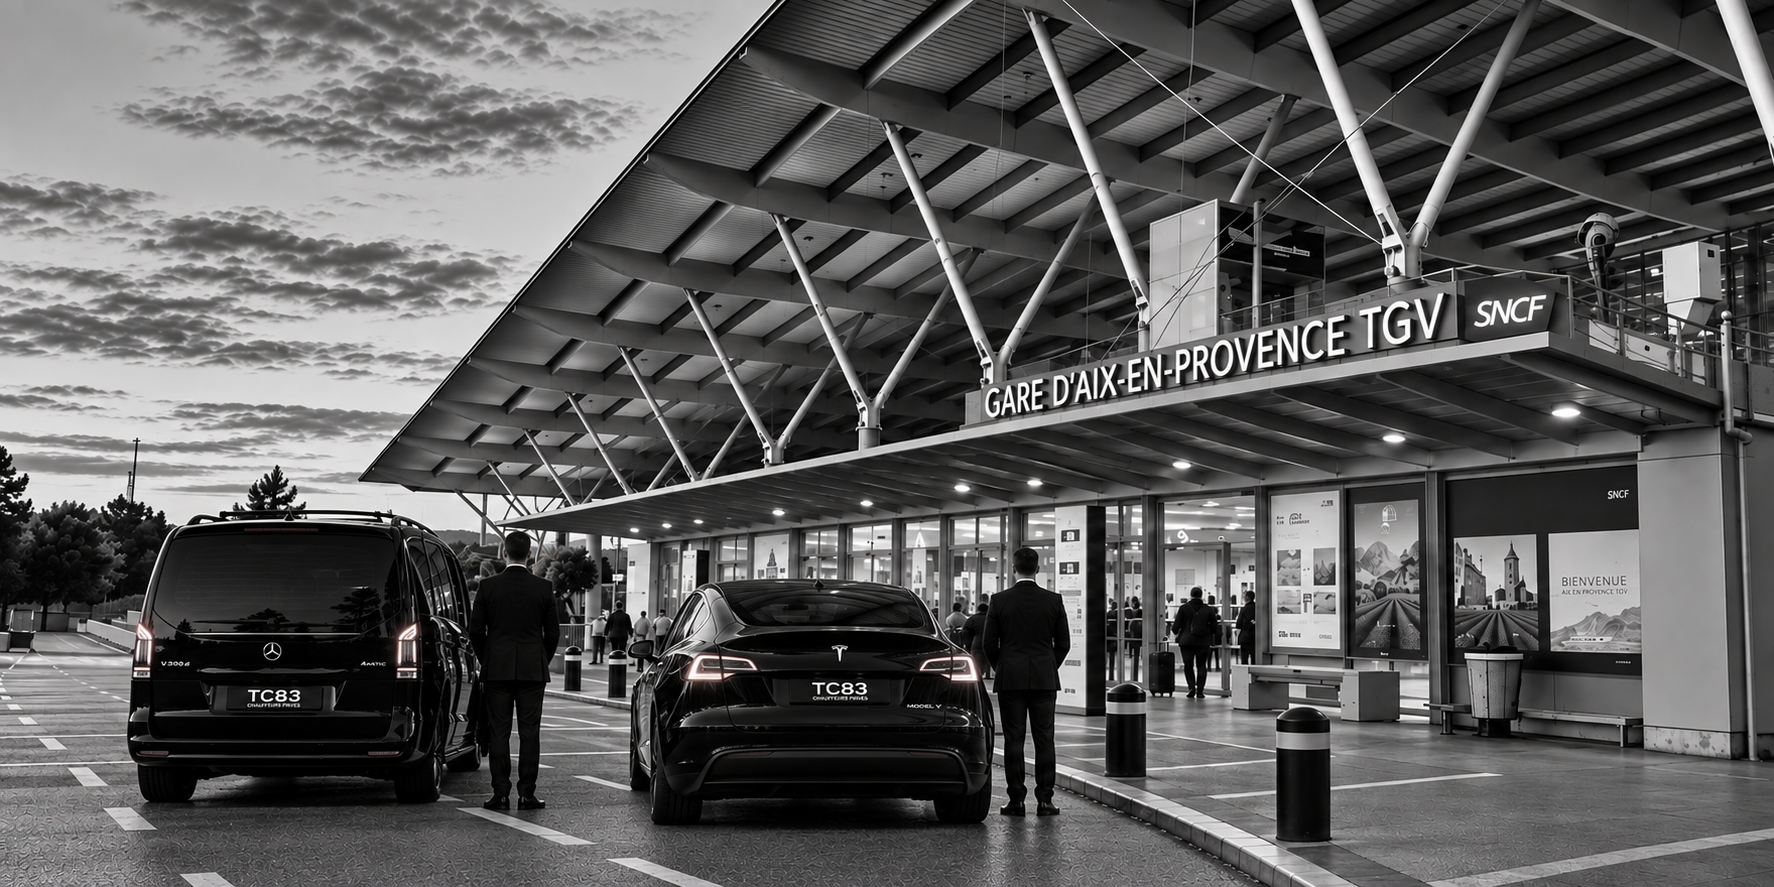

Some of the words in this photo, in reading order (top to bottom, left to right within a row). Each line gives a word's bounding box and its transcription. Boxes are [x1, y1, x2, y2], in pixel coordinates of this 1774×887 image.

[1473, 294, 1548, 328] SNCF
[985, 378, 1044, 418] GARE
[1053, 315, 1346, 407] D'AIX-EN-PROVENCE
[1359, 292, 1446, 349] TGV
[1607, 489, 1630, 500] SNCF
[1561, 575, 1627, 586] BIENVENUE
[811, 682, 868, 695] TC83
[247, 689, 301, 702] TC83
